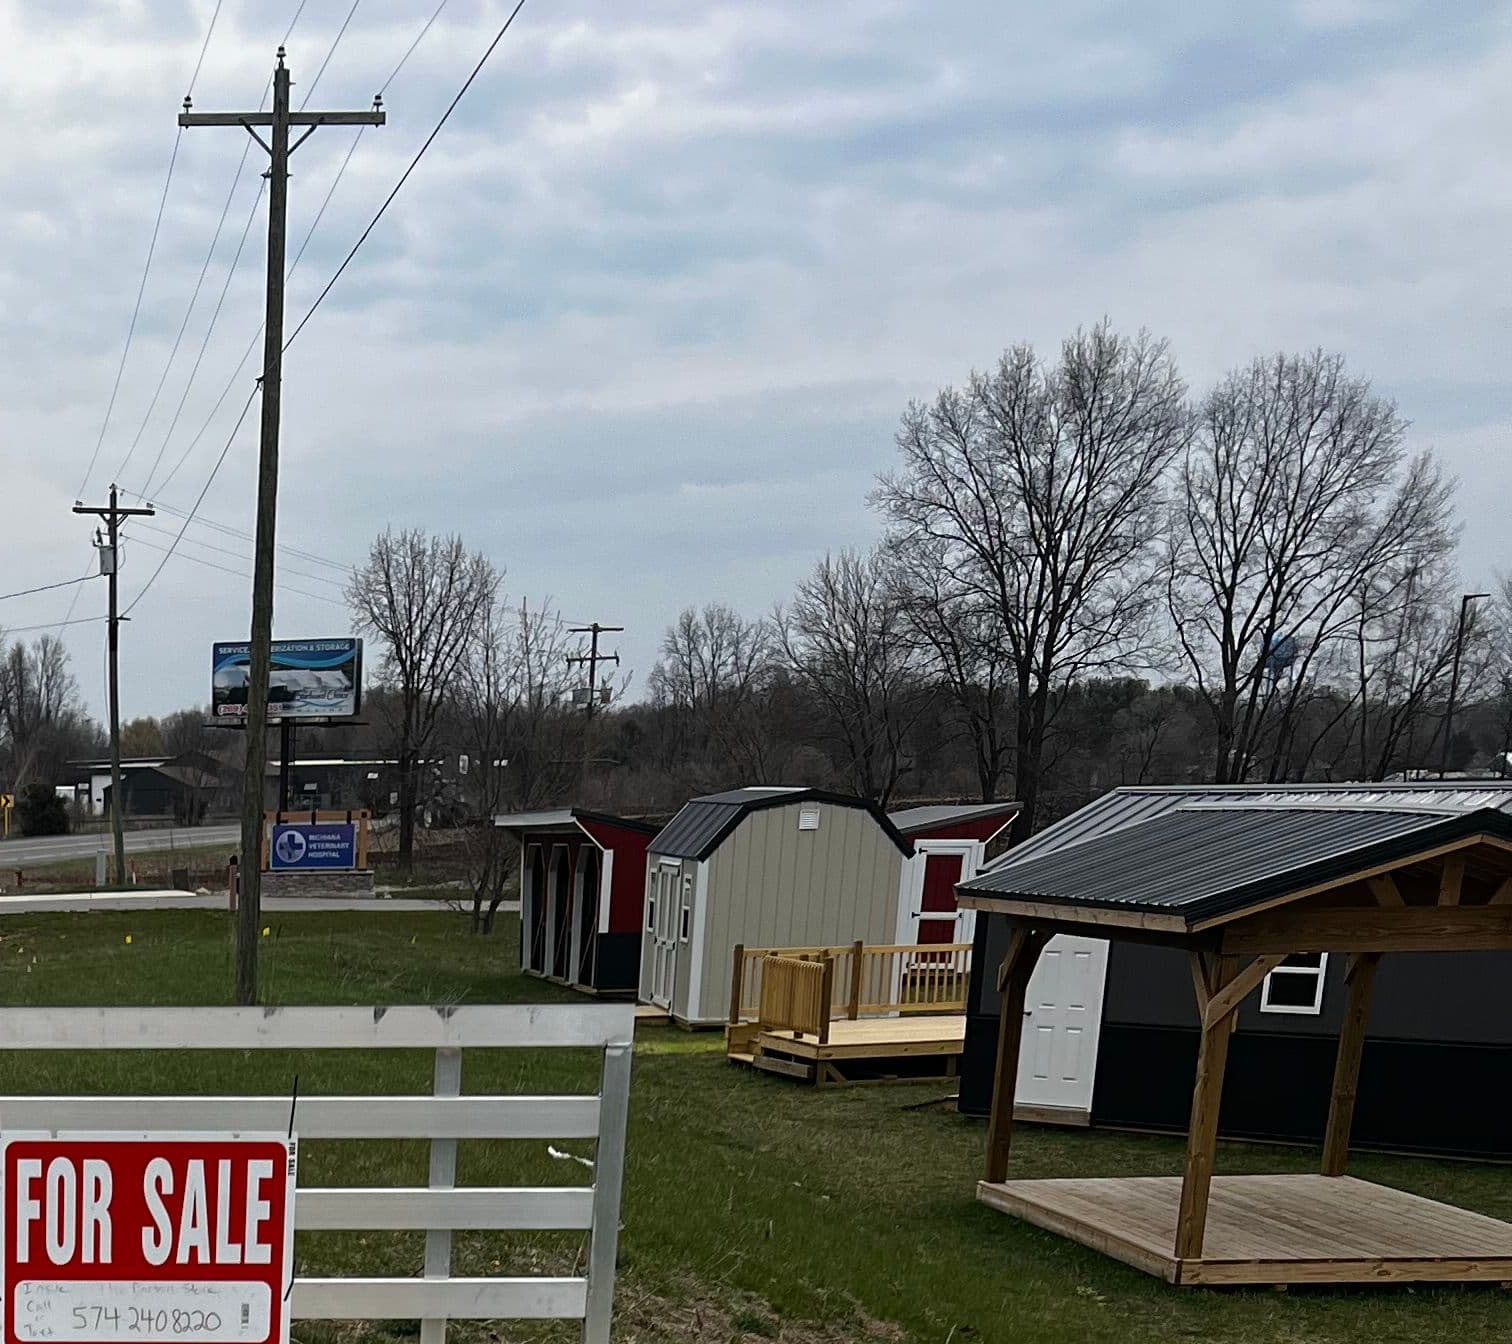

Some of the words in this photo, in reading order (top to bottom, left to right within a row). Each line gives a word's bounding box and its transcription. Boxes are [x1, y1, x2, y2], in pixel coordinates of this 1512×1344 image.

[308, 842, 350, 850] VETERINARY
[17, 1157, 113, 1265] FOR
[141, 1157, 273, 1266] SALE
[72, 1306, 121, 1333] 574
[128, 1306, 222, 1334] 2408220
